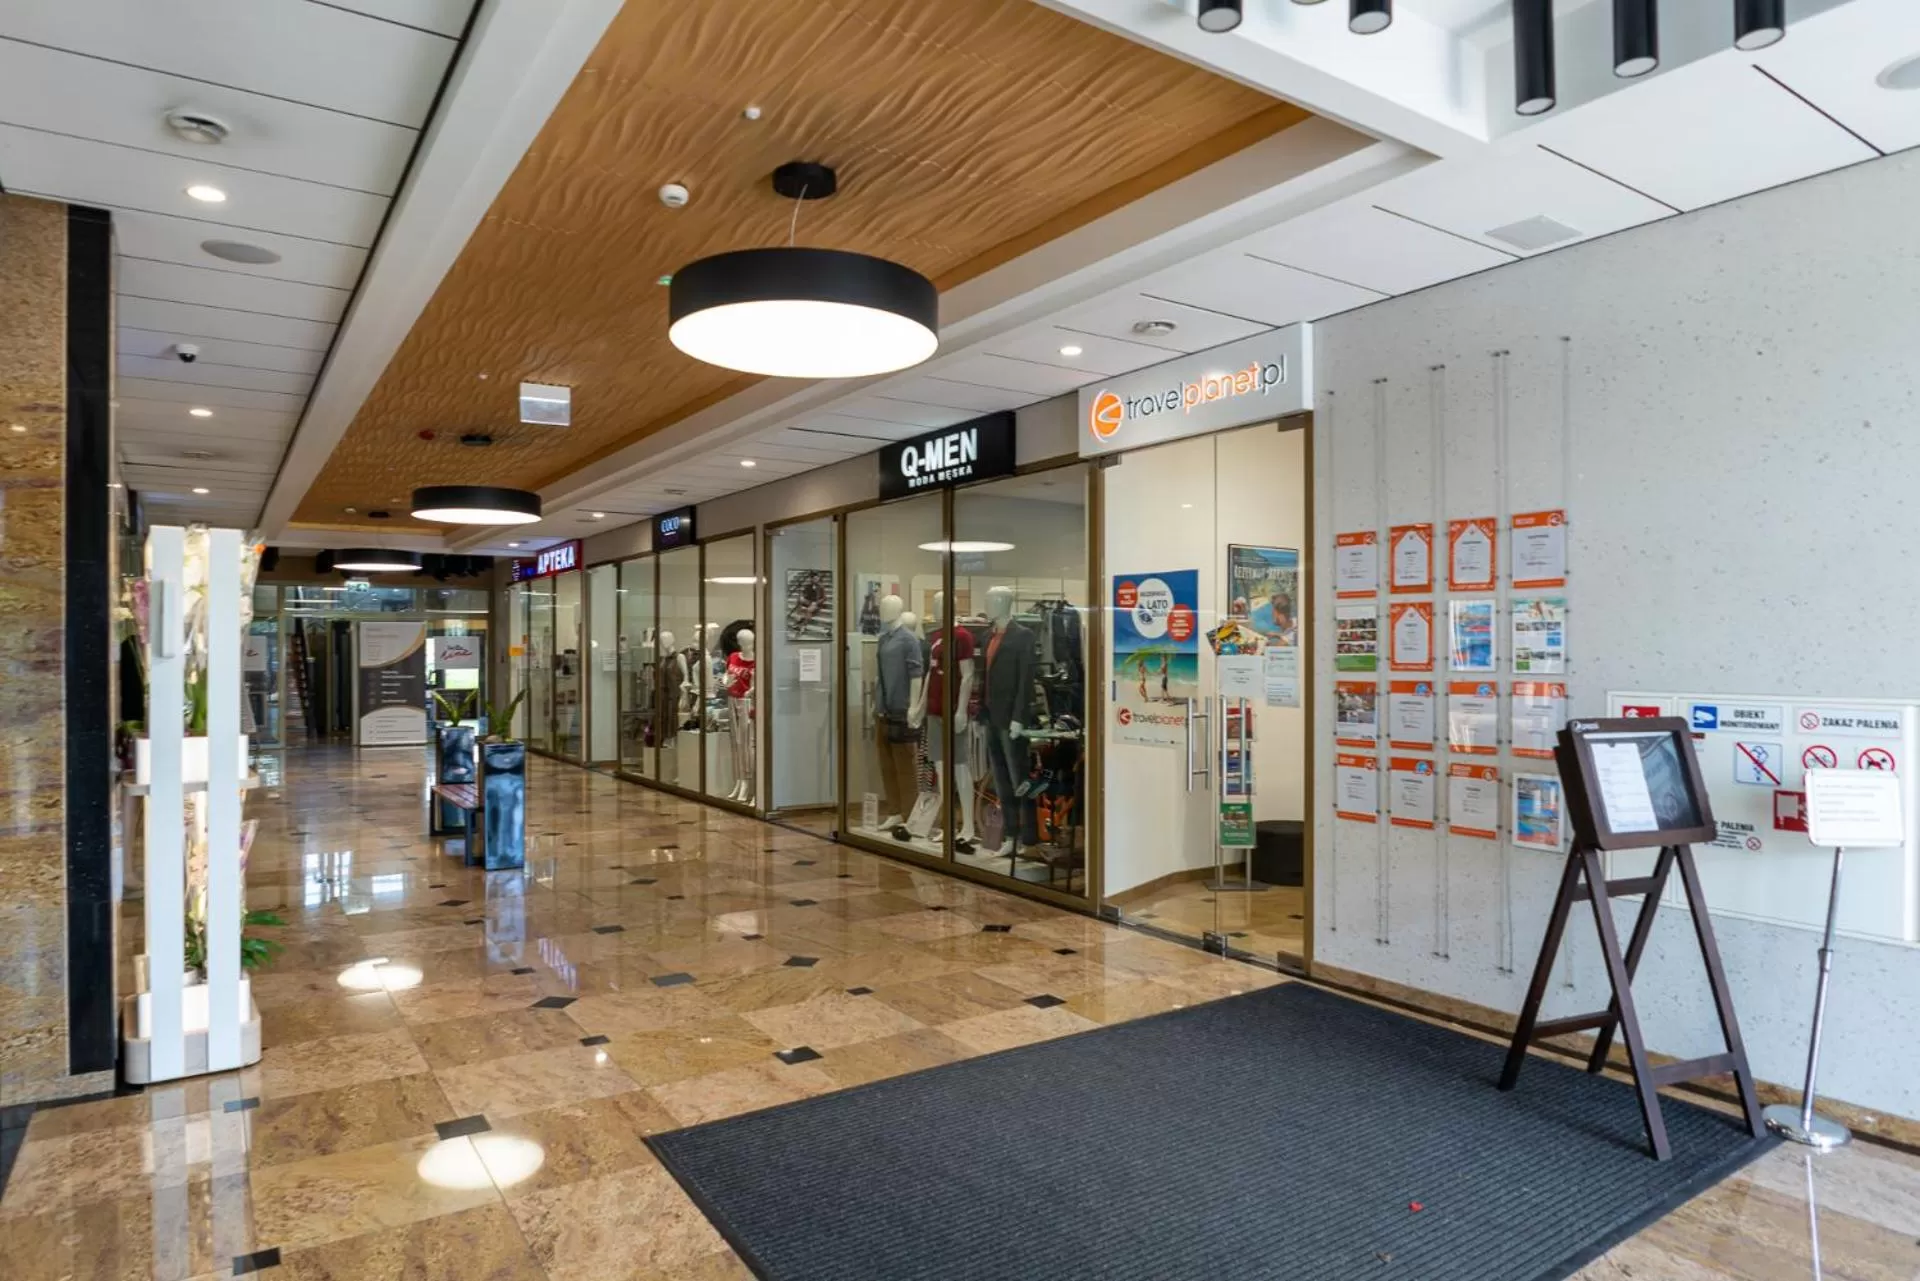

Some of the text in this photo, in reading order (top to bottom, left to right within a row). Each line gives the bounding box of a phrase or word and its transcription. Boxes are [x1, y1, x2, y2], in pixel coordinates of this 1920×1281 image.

[1126, 354, 1287, 420] travelplanet.pl
[901, 428, 977, 478] Q-MEN
[908, 465, 973, 488] MODA MĘSKA
[537, 546, 574, 574] APTEKA
[1147, 600, 1168, 609] LATO
[1733, 709, 1765, 719] OBIEKT
[1719, 720, 1780, 730] MONITOROWANY
[1822, 717, 1899, 730] ZAKAZ PALENIA
[1720, 821, 1755, 831] PALENIA
